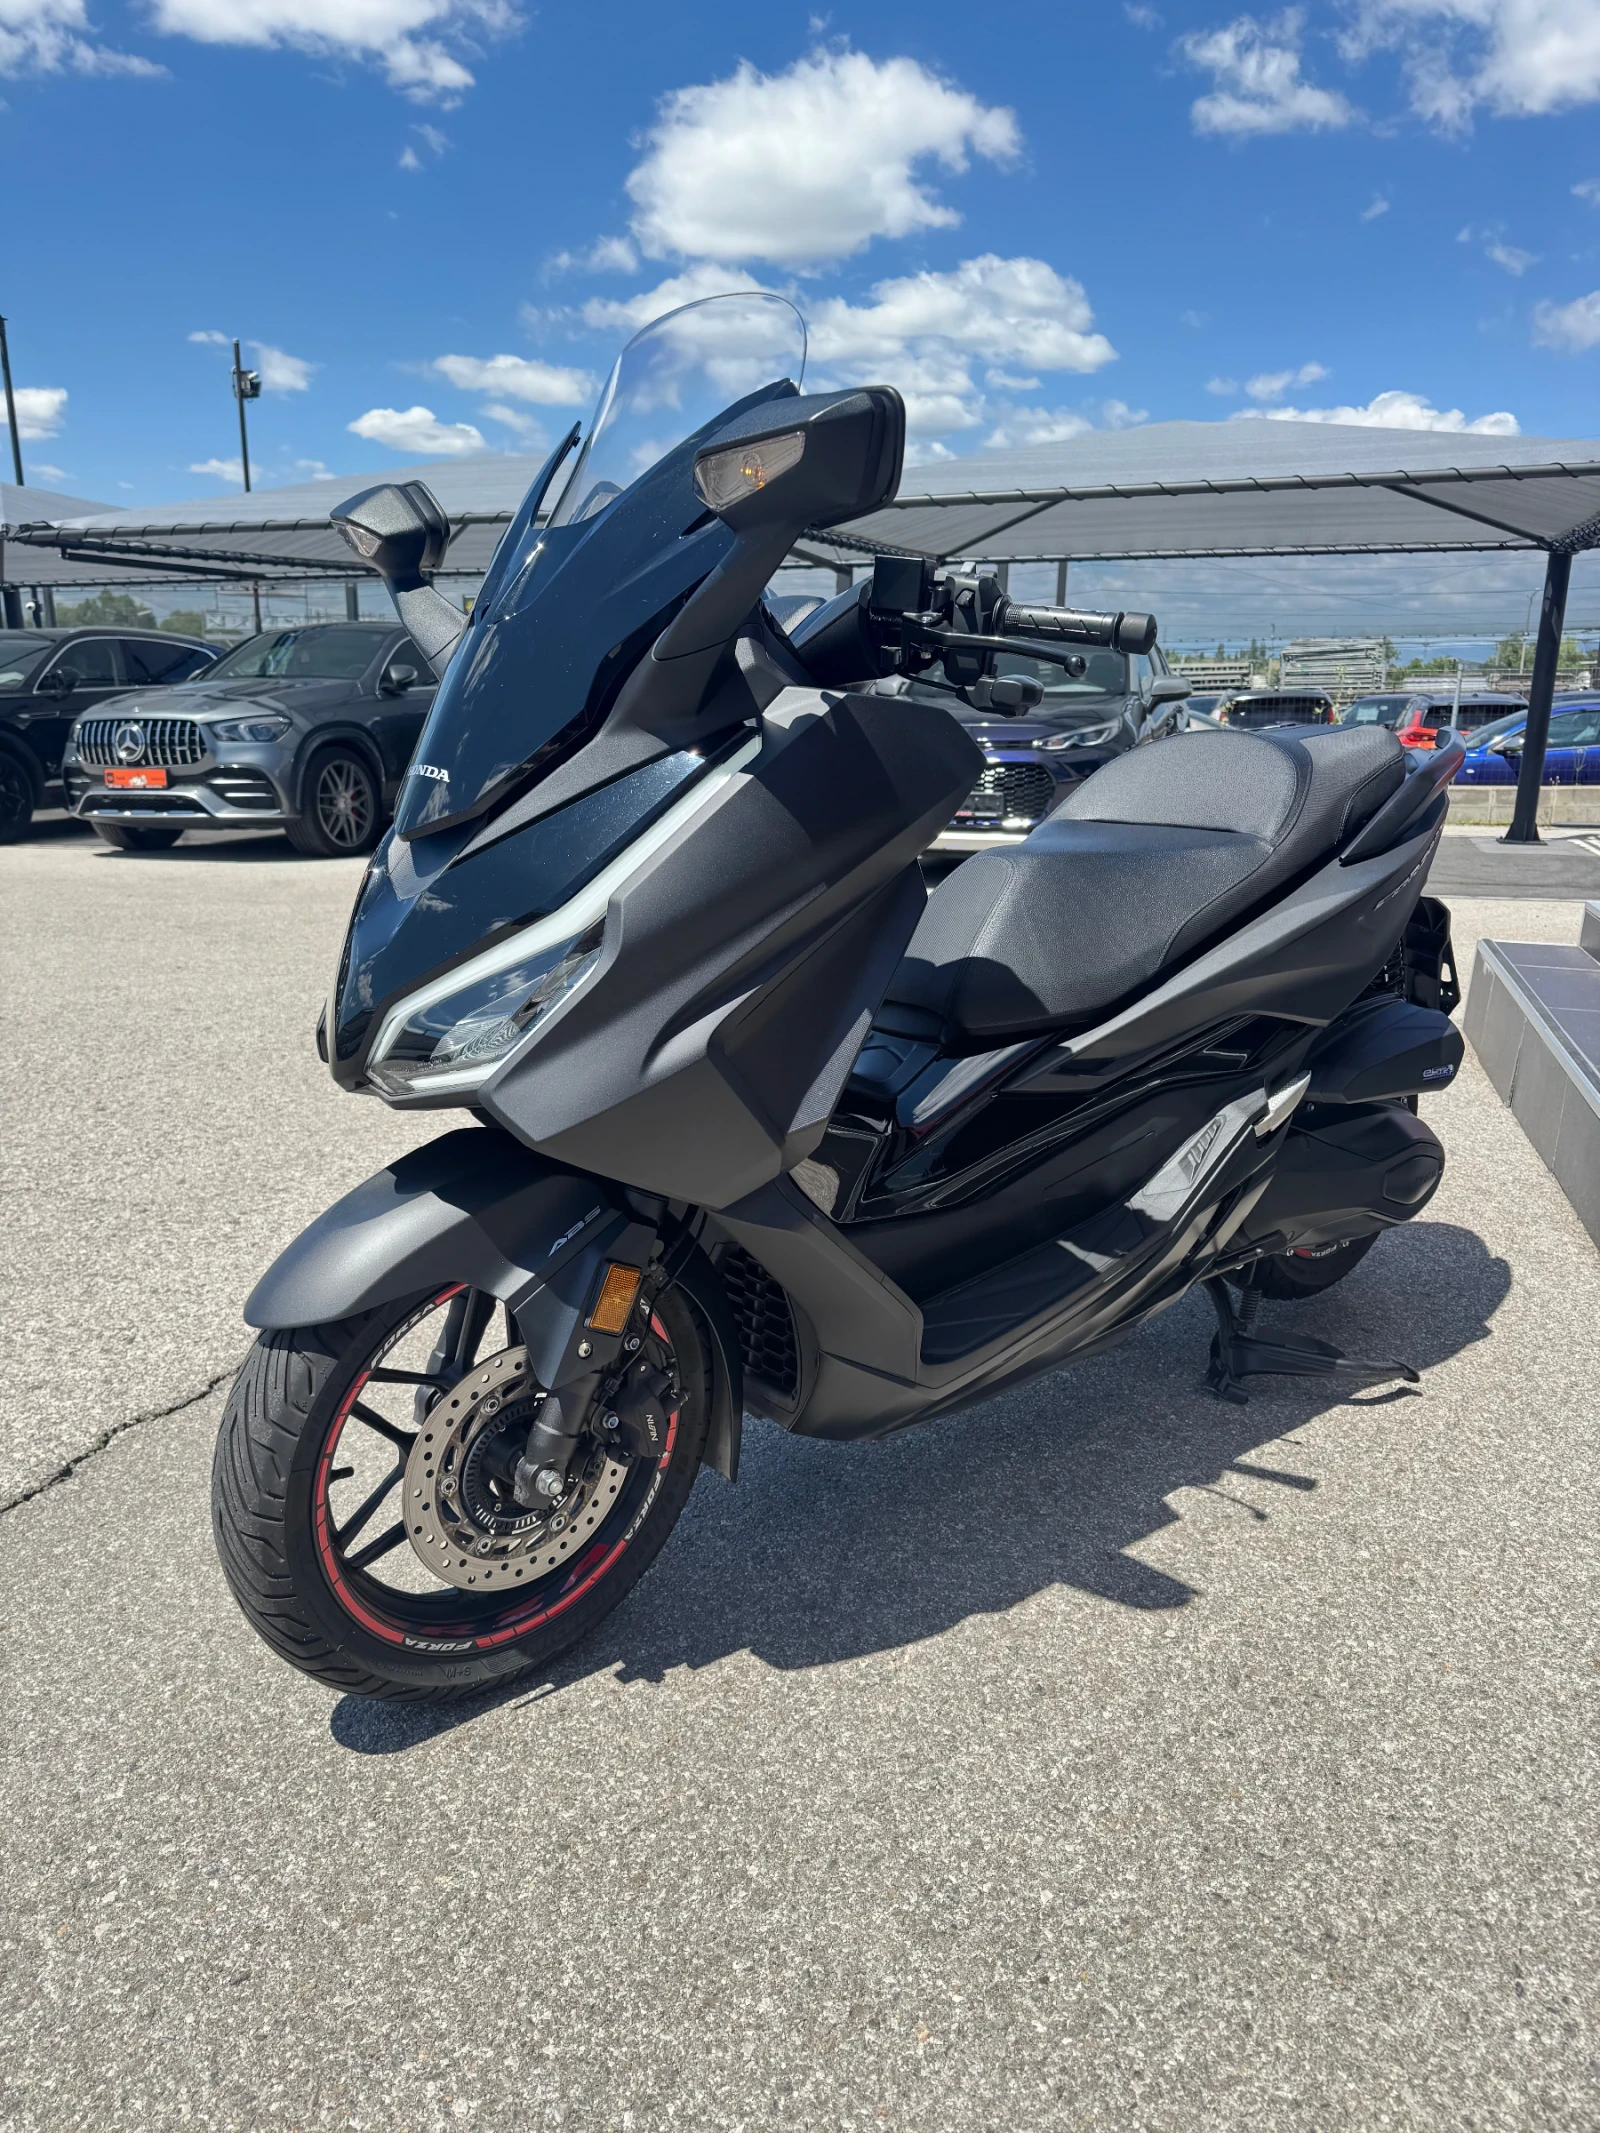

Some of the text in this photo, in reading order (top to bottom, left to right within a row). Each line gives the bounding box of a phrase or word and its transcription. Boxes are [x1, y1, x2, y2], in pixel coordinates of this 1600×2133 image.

[547, 1204, 601, 1258] ABS
[371, 1303, 436, 1370] FORZA
[624, 1471, 662, 1540] FORZA
[405, 1637, 473, 1652] FORZA
